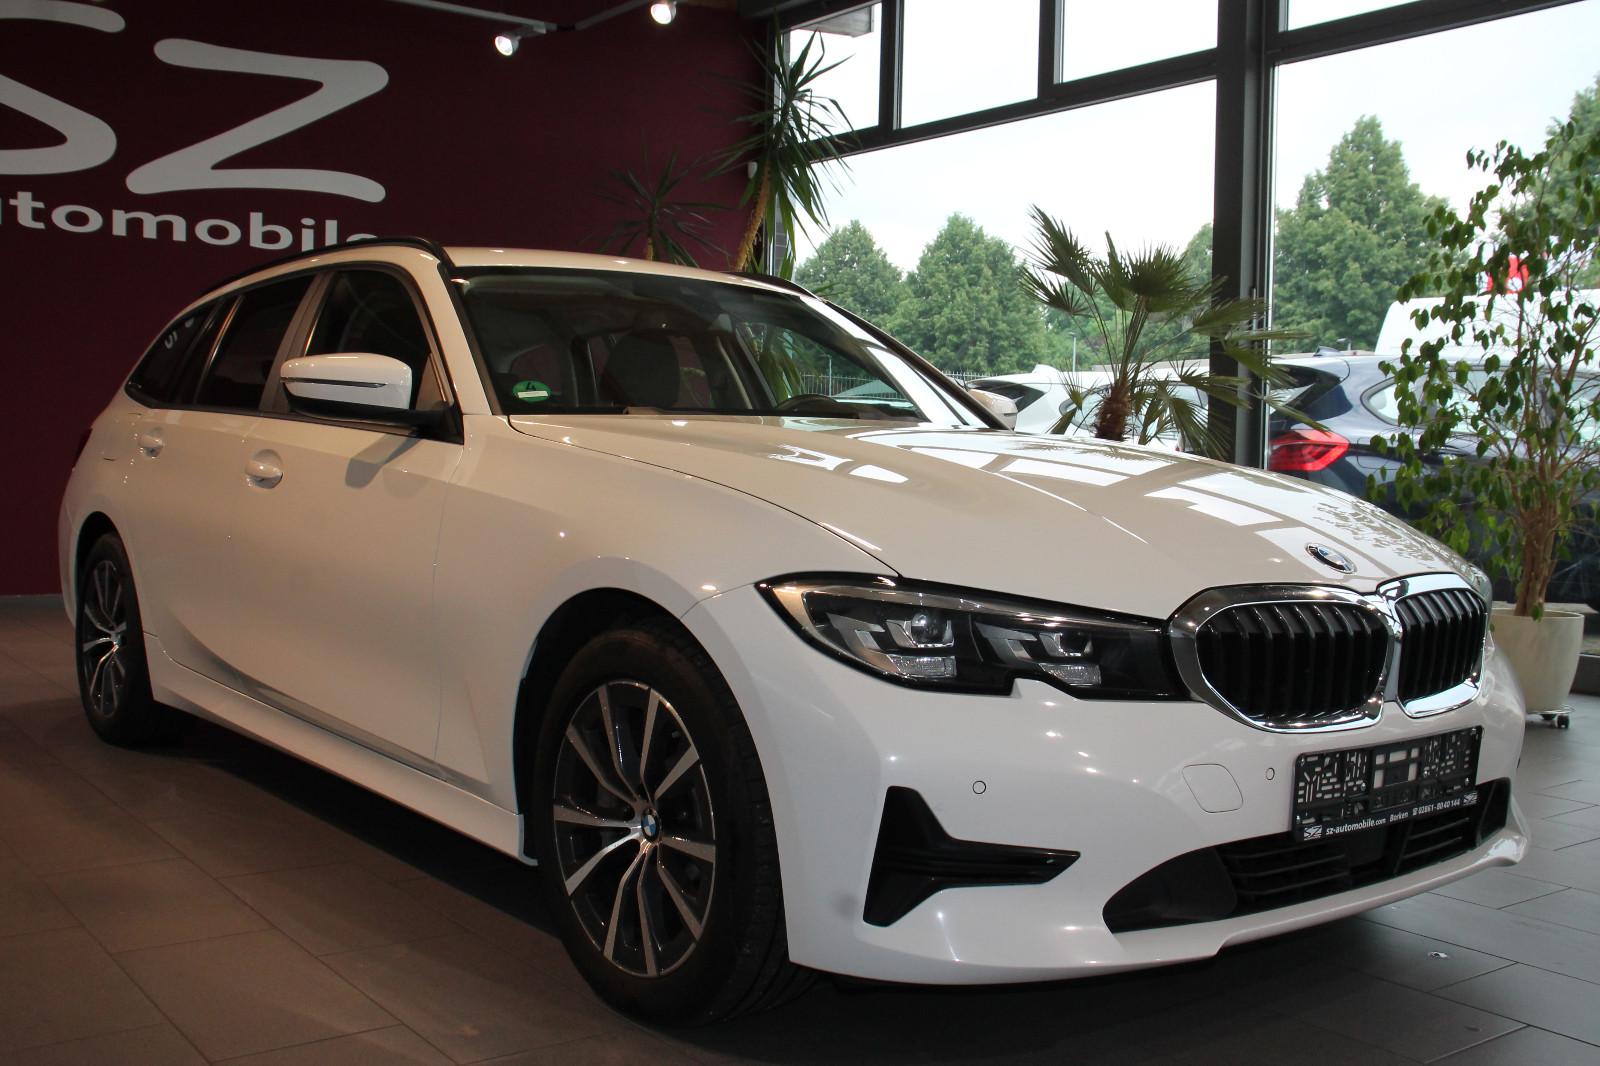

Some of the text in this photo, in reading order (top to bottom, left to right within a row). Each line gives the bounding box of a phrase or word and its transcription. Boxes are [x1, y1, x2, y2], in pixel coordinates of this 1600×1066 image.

[0, 191, 378, 252] tomobil
[1326, 818, 1386, 835] sz-automobile.com
[1389, 811, 1409, 823] Borken
